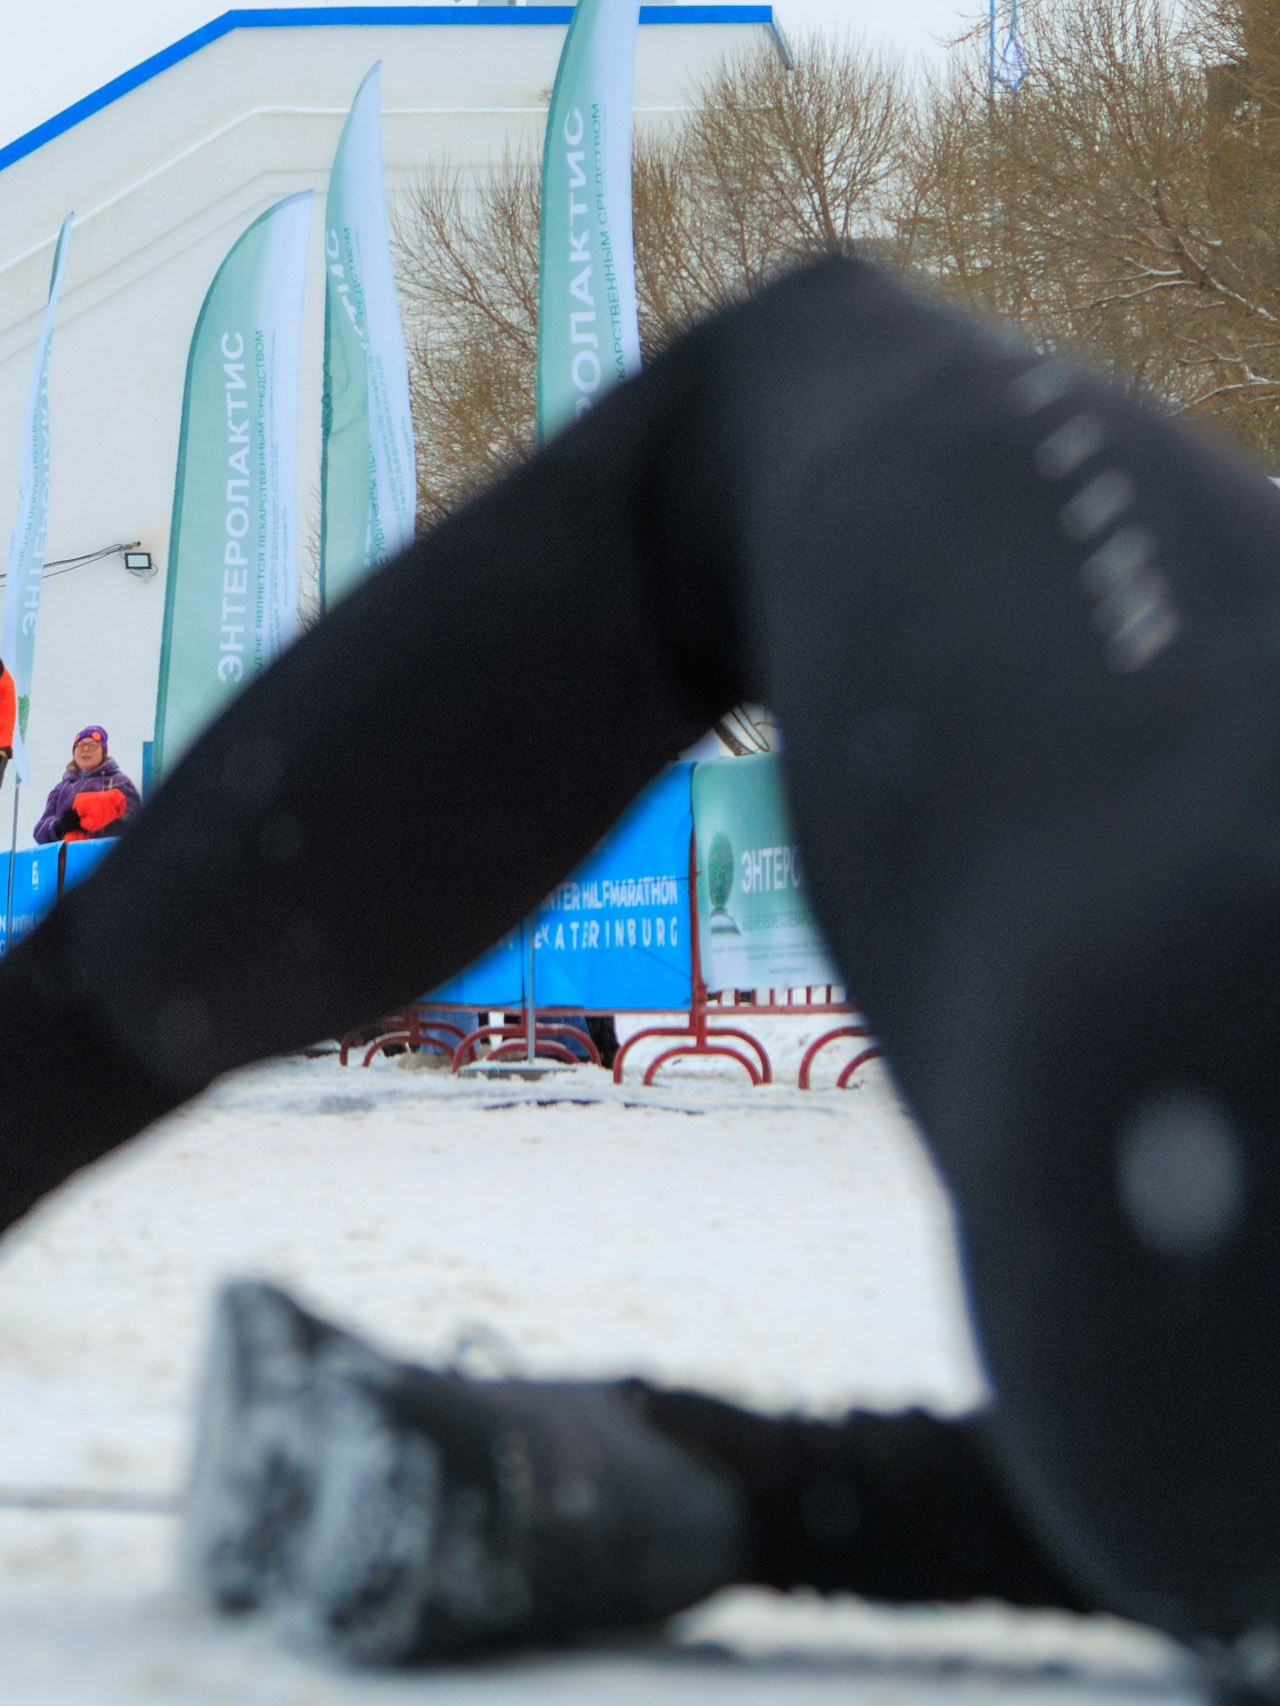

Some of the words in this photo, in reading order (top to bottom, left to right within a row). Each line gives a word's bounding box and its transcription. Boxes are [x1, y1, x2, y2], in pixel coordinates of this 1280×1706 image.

[591, 103, 607, 225] СРЕДСТВОМ
[343, 226, 365, 319] РЕДСТВОМ
[600, 230, 625, 379] КАРСТВЕННЫМ
[255, 330, 266, 419] СРЕДСТВОМ
[217, 331, 250, 684] ЭНТЕРОЛАКТИС
[257, 421, 268, 548] ЛЕКАРСТВЕННЫМ
[255, 551, 267, 629] ЯВЛЯЕТСЯ
